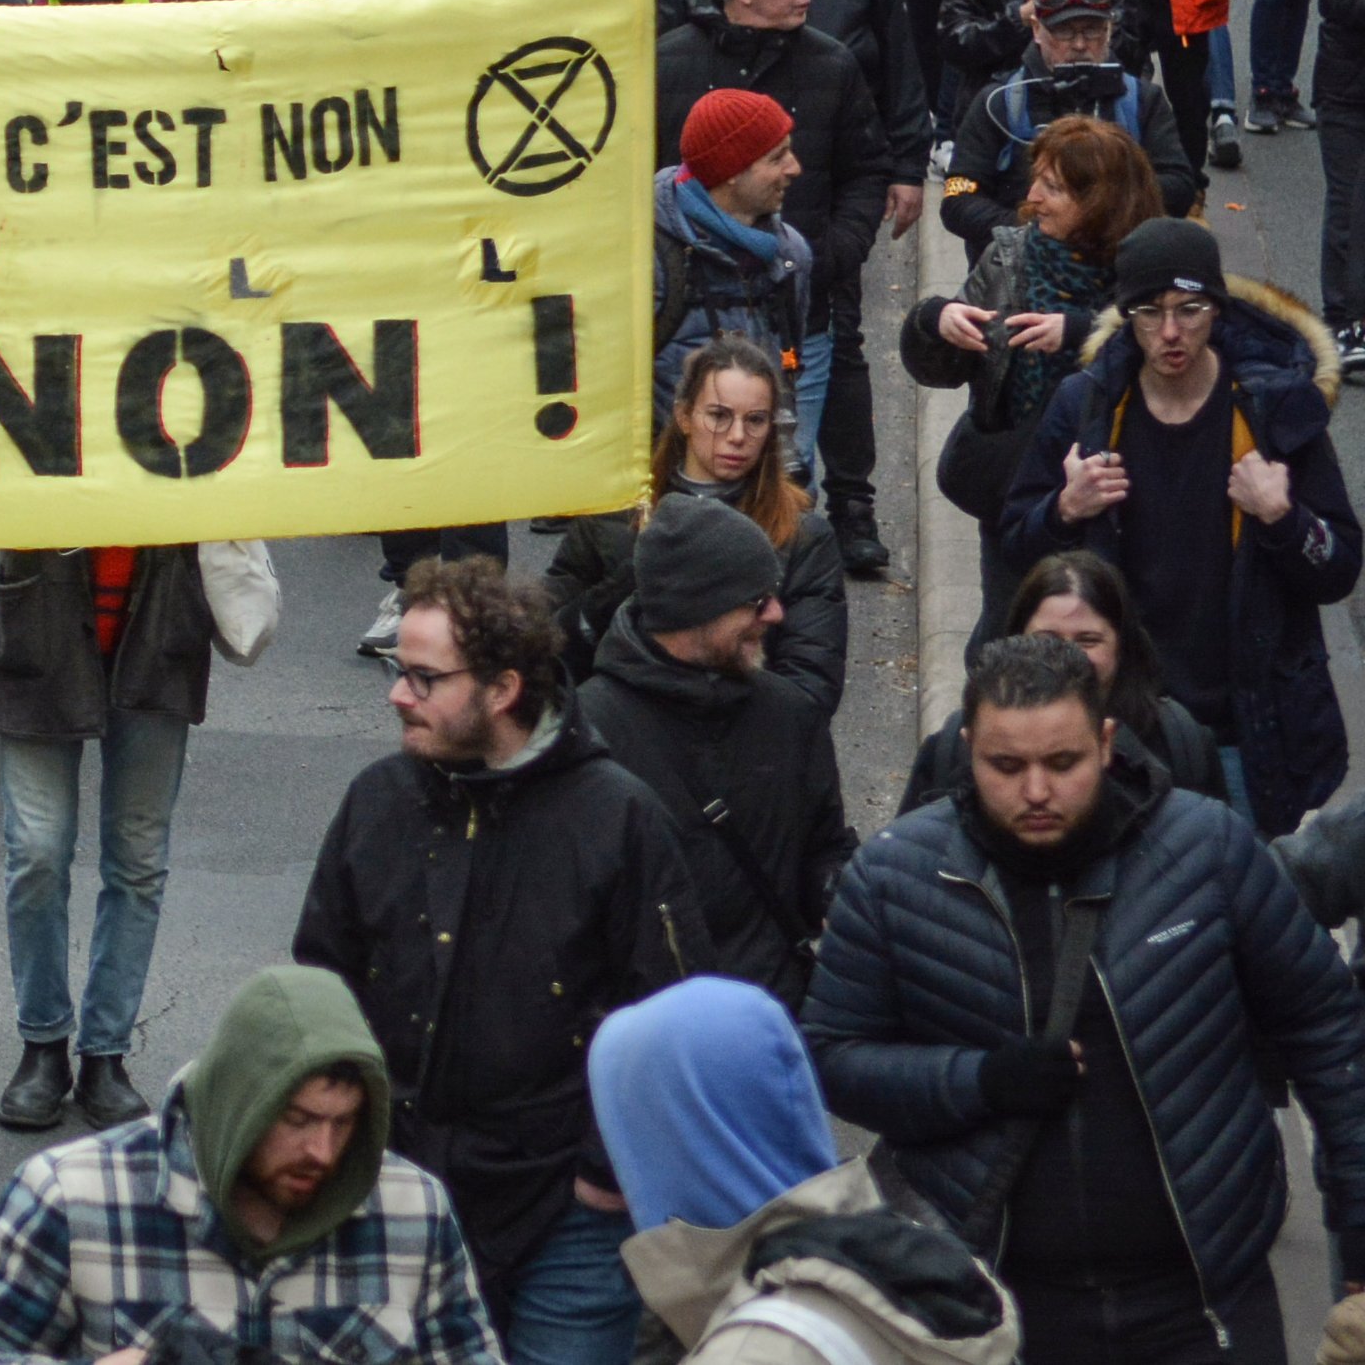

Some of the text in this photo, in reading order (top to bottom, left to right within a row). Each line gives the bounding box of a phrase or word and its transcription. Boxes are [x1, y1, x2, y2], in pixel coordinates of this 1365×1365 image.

[6, 100, 226, 193] C'EST
[262, 86, 401, 182] NON
[531, 294, 579, 441] !
